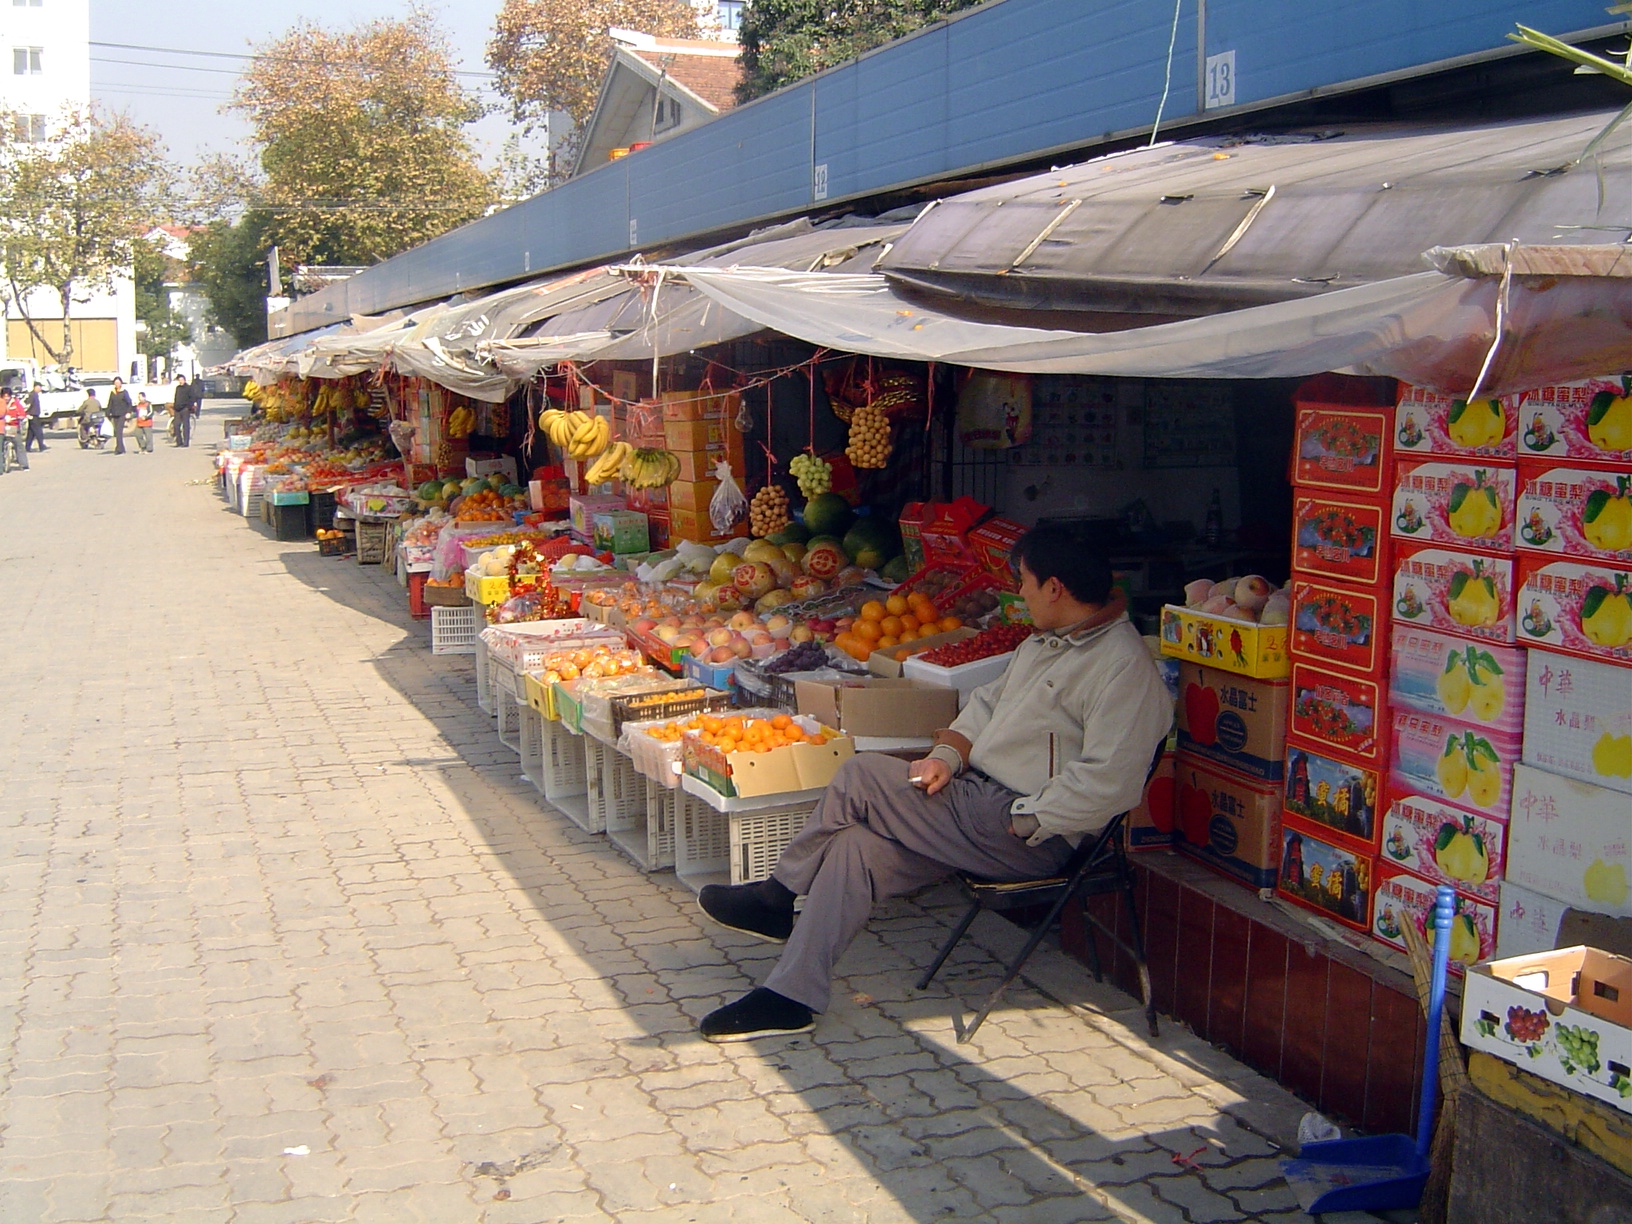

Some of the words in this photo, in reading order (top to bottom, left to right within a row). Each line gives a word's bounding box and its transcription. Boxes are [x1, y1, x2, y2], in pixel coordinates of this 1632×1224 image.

[1210, 62, 1231, 99] 13
[1525, 479, 1584, 500] 冰糖蜜梨
[1526, 570, 1583, 596] 冰糖蜜梨
[1220, 684, 1257, 712] 水晶富士
[1211, 789, 1245, 819] 水晶富士
[1316, 779, 1350, 816] 蜜橘
[1309, 861, 1342, 900] 蜜橘
